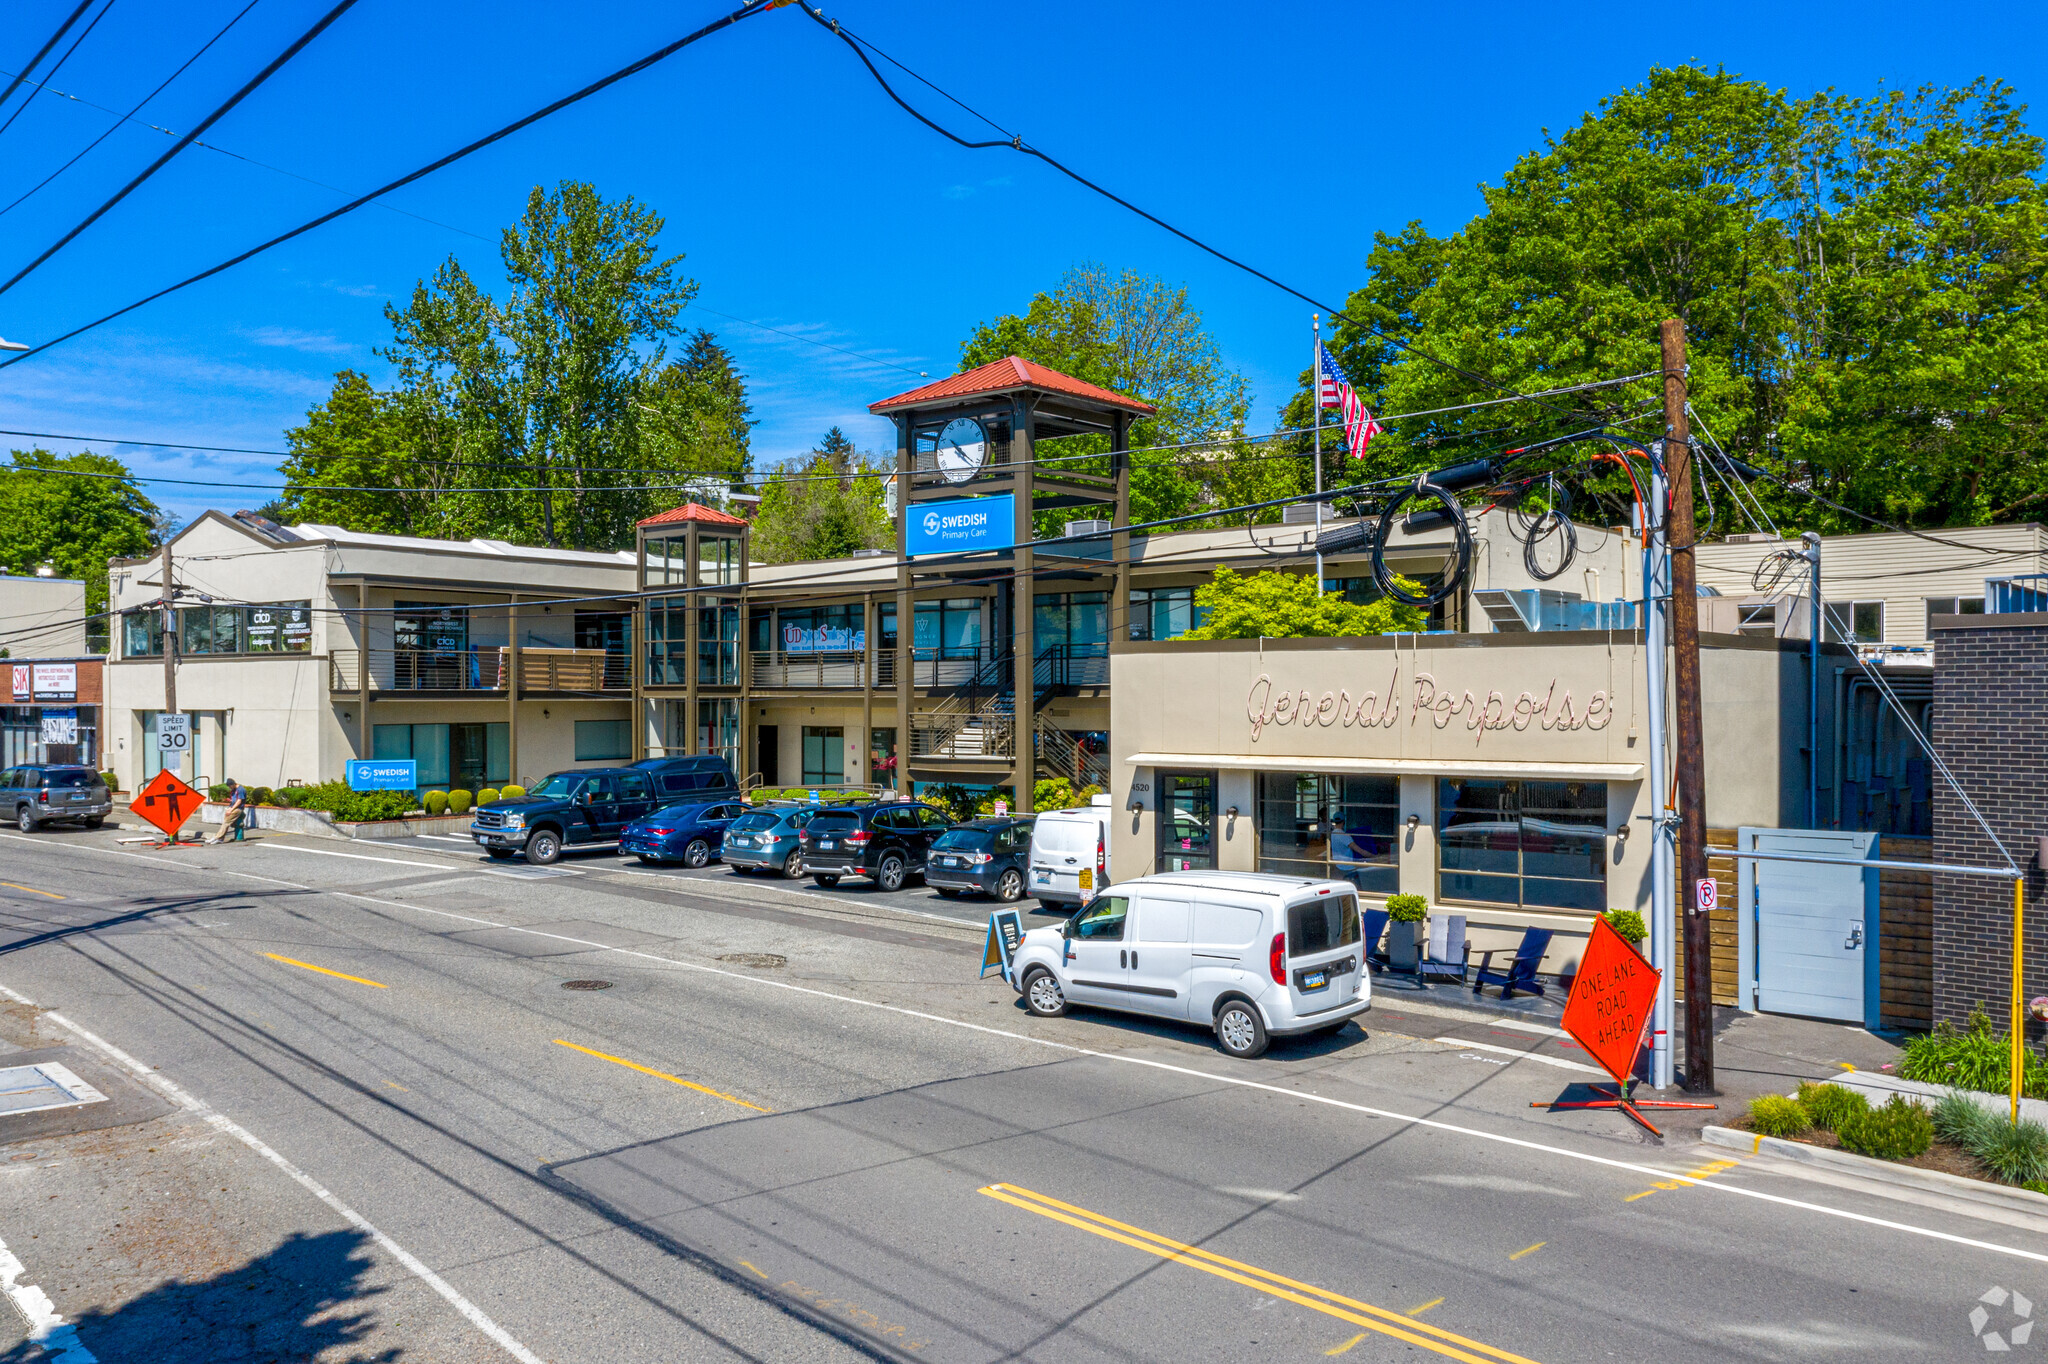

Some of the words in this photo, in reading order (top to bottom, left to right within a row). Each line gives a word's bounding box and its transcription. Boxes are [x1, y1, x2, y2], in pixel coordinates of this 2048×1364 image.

[942, 513, 987, 529] SWEDISH
[942, 530, 969, 540] Primary
[971, 528, 987, 537] Care
[13, 668, 28, 691] SIK
[1247, 667, 1399, 742] General
[1411, 672, 1612, 747] Porpoise
[161, 733, 186, 748] 30
[1132, 783, 1150, 792] 4520
[1580, 973, 1605, 1000] ONE
[1608, 958, 1636, 987] LANE
[1596, 990, 1627, 1020] ROAD
[1598, 1014, 1635, 1048] AHEAD
